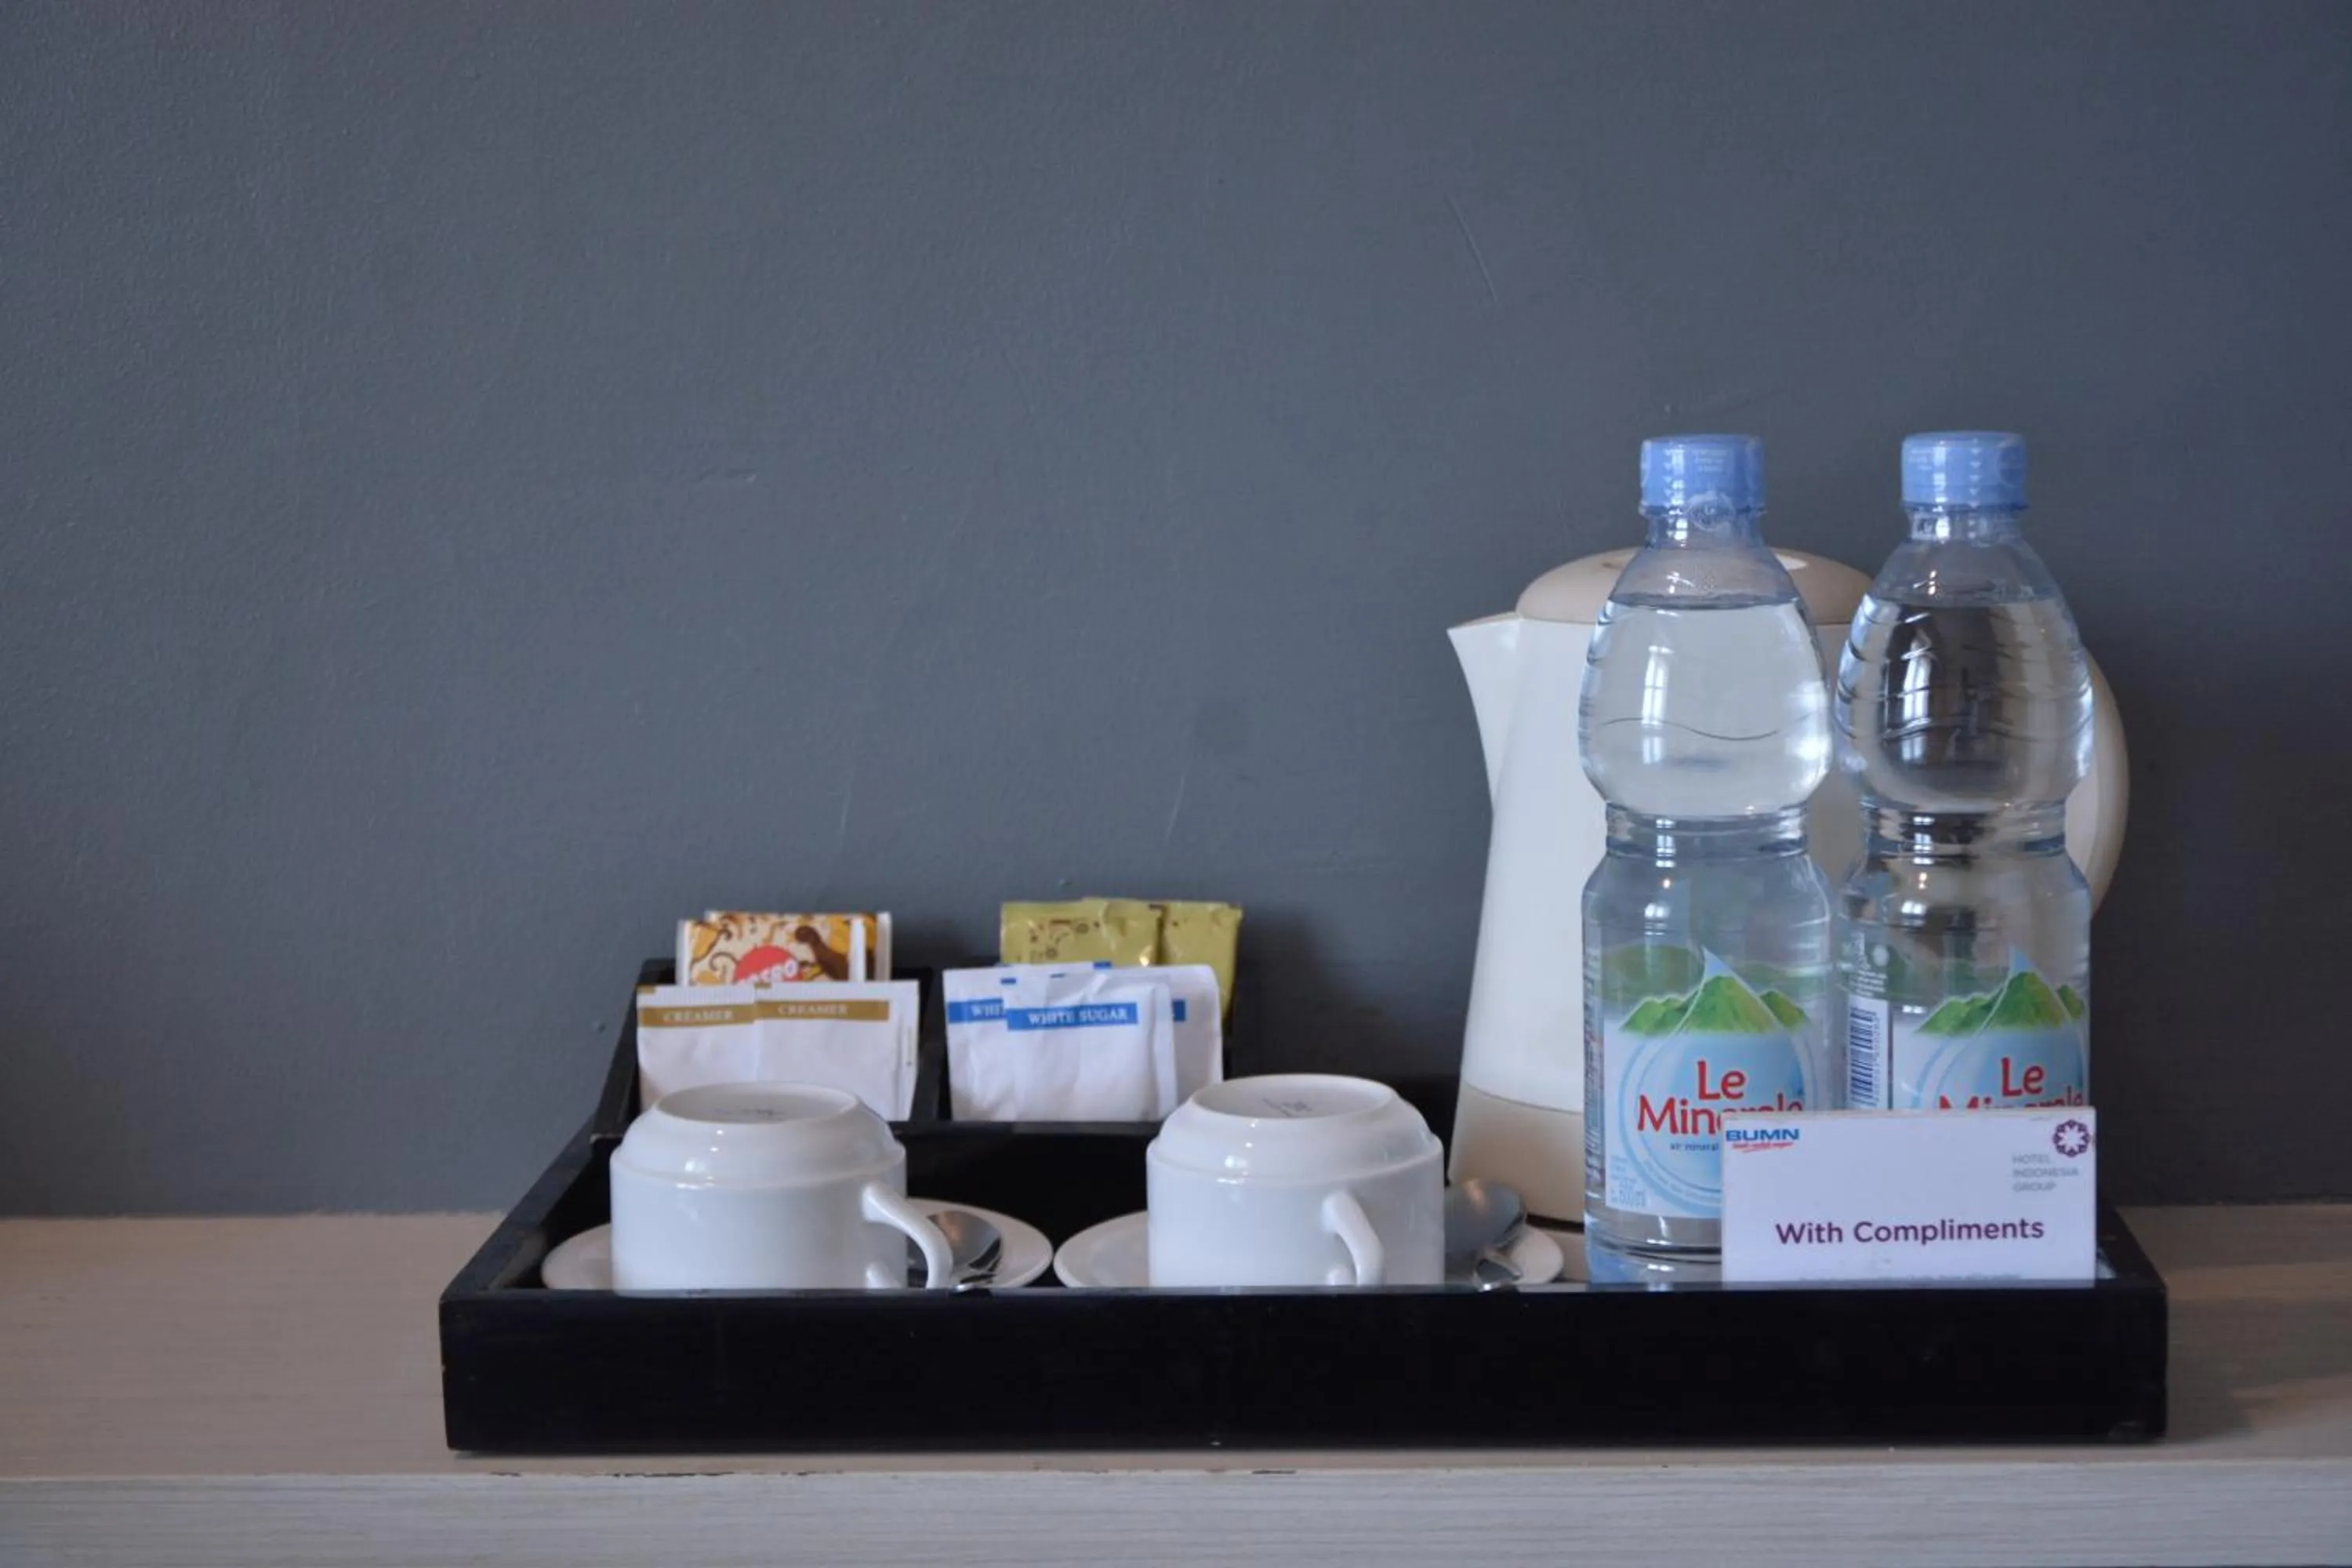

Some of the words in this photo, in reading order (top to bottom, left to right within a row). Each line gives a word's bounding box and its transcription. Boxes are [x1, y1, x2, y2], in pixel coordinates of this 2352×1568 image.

[662, 1008, 734, 1022] CREAMER
[778, 1004, 848, 1016] CREAMER
[970, 1004, 1006, 1018] WHI
[1027, 1011, 1075, 1025] WHITE
[1080, 1008, 1127, 1024] SUGAR
[1697, 1060, 1746, 1100] Le
[2001, 1056, 2045, 1096] Le
[1726, 1128, 1800, 1142] BUMN
[2012, 1153, 2051, 1164] HOTEL
[2012, 1167, 2079, 1178] INDONESIA
[2012, 1181, 2056, 1192] GROUP
[1776, 1222, 1843, 1245] With
[1853, 1218, 2045, 1246] Compliments
